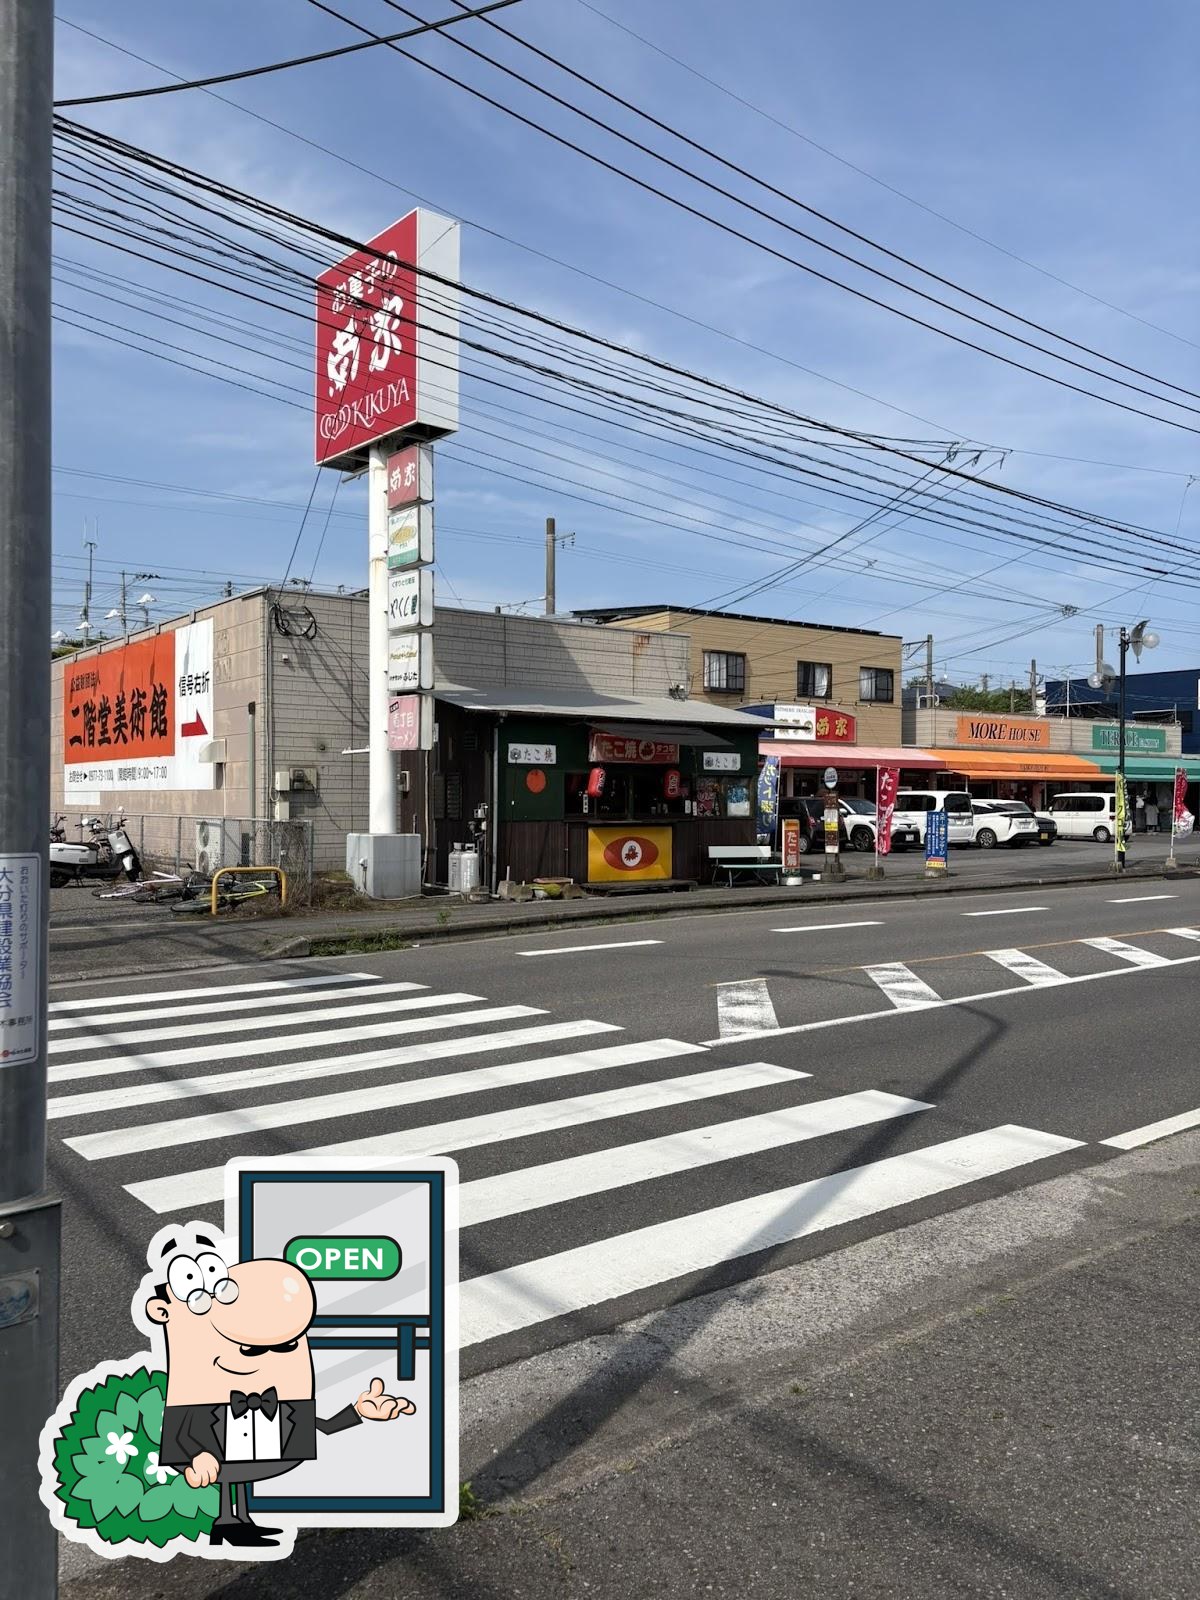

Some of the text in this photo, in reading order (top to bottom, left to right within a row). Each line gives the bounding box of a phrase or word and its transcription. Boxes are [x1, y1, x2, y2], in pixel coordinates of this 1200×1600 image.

[353, 377, 410, 427] KIKUYA
[179, 670, 210, 698] 信号右折
[69, 682, 168, 748] 二階堂美術館
[968, 722, 1041, 742] MORE HOUSE
[523, 747, 554, 762] たこ焼
[601, 740, 637, 760] たこ焼
